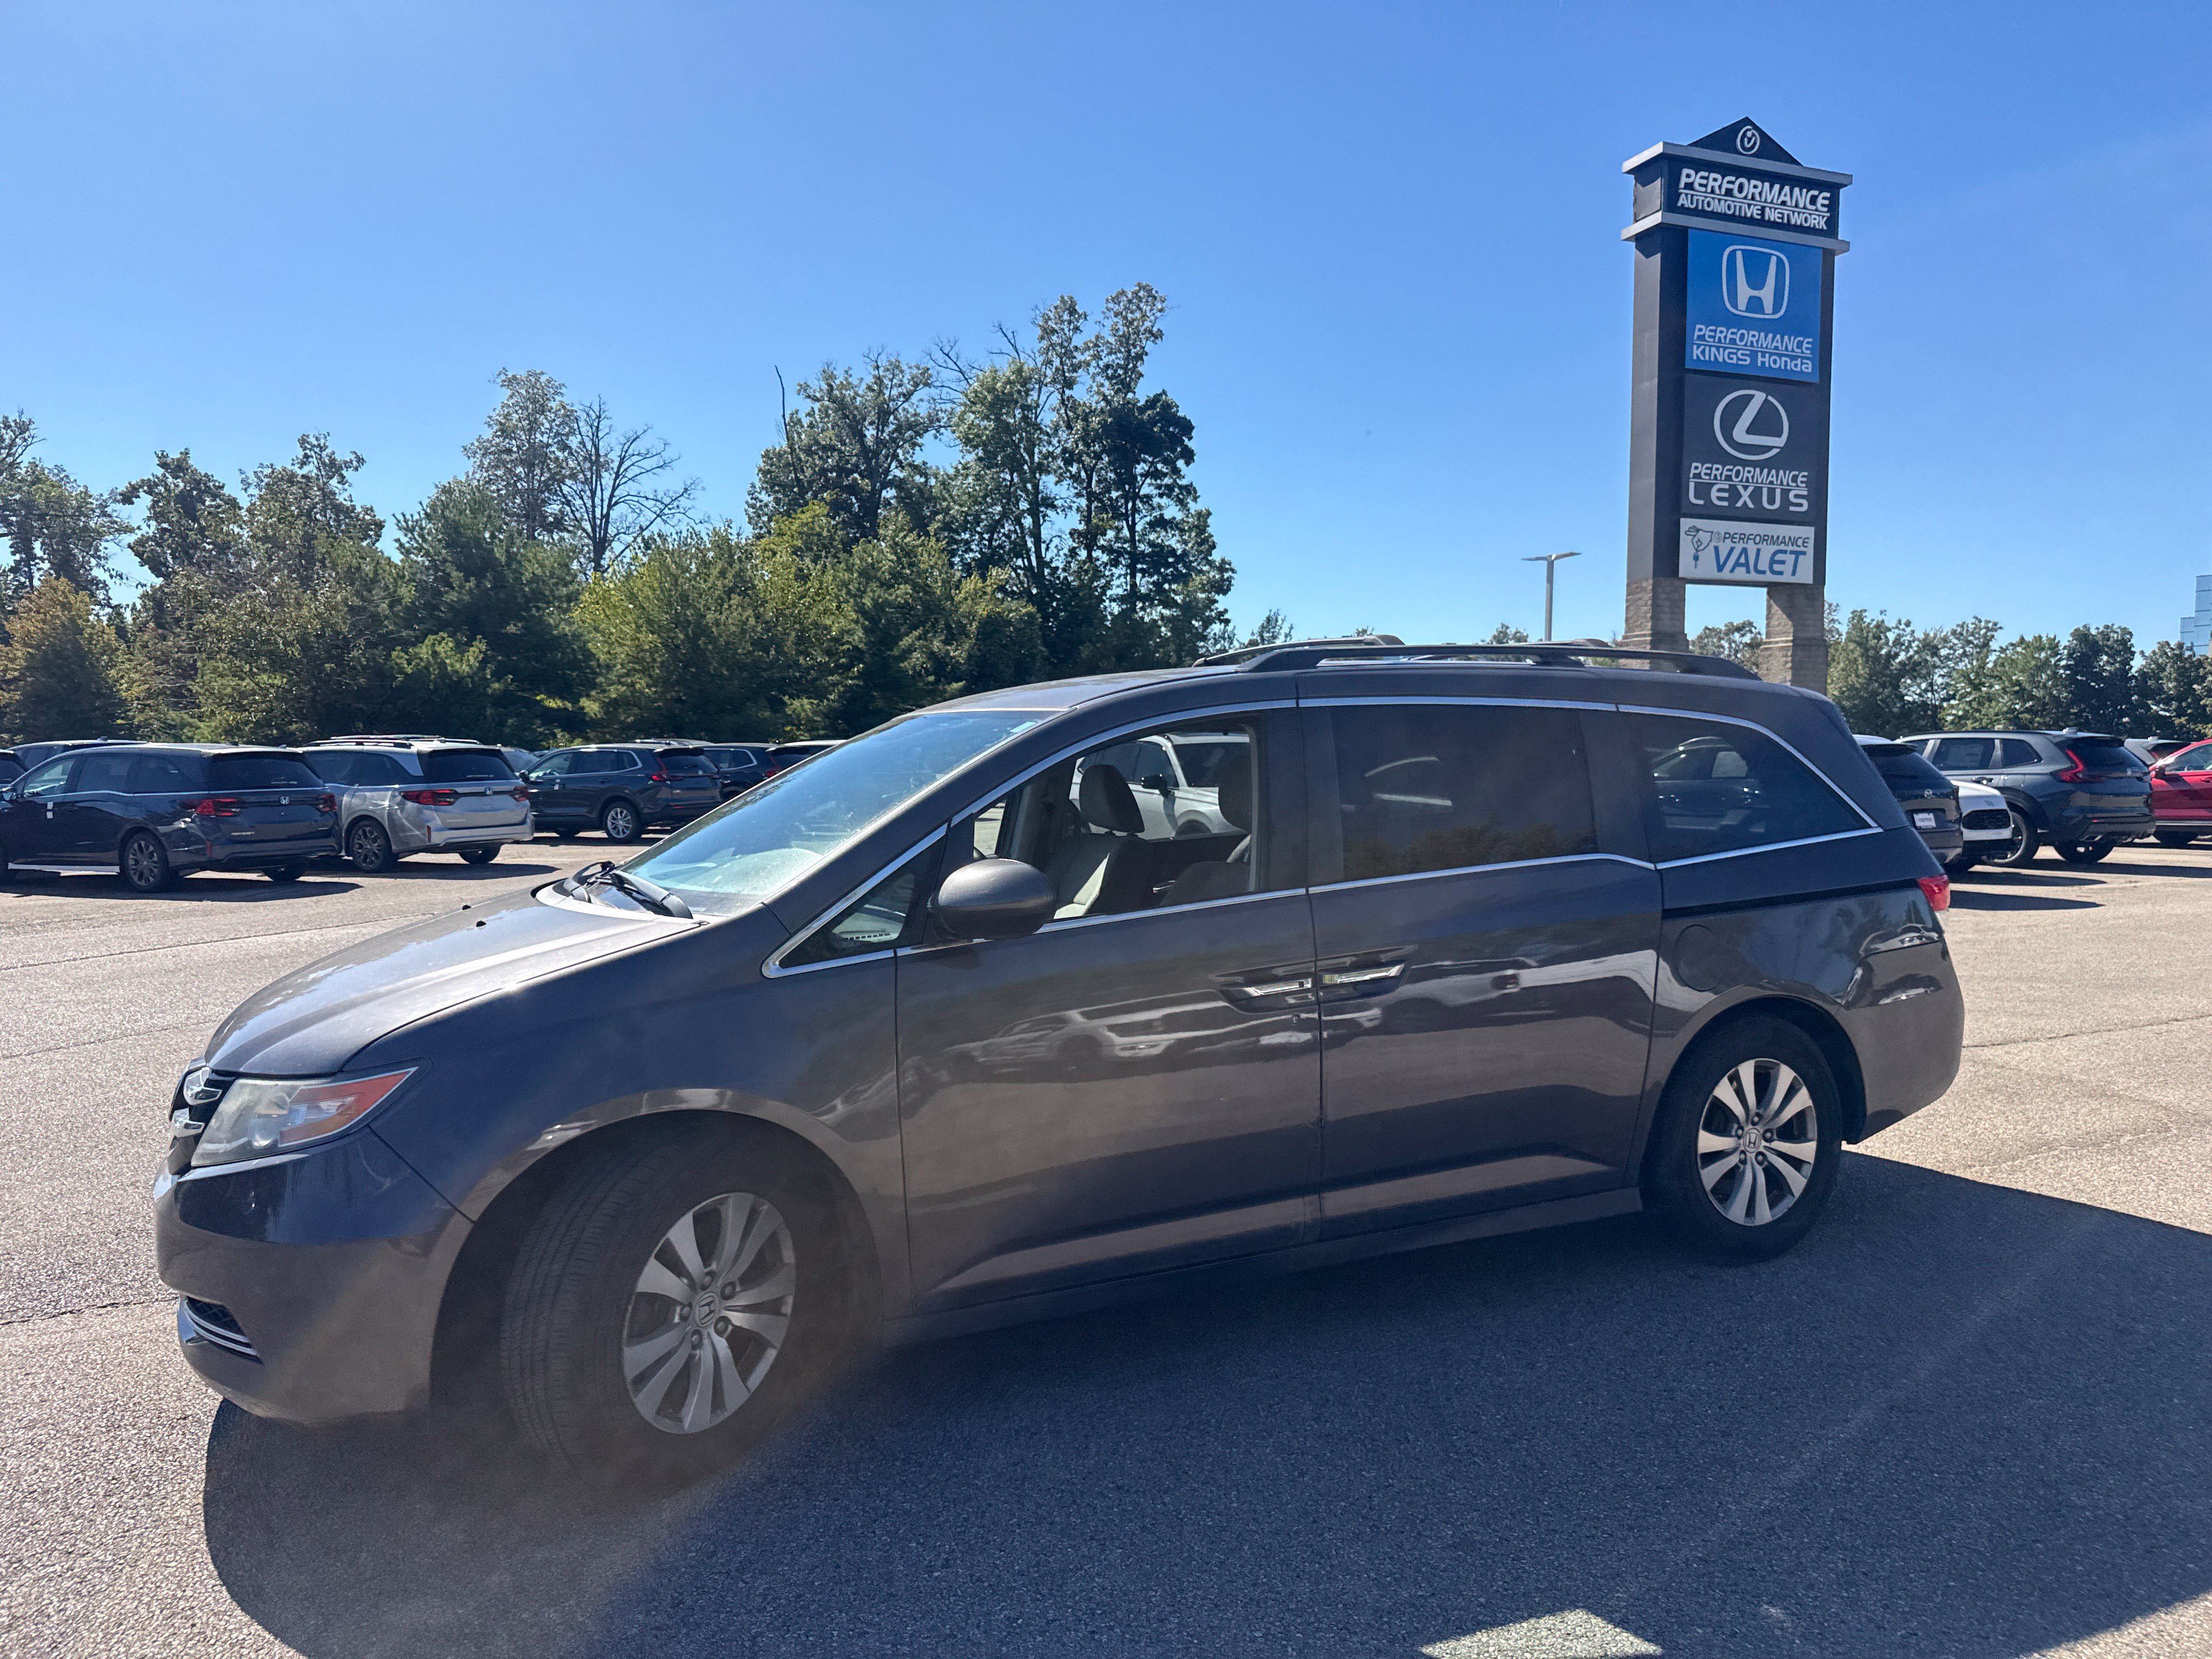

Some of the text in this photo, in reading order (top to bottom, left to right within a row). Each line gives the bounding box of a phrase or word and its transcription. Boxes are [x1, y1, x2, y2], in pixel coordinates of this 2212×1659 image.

[1678, 168, 1831, 212] PERFORMANCE
[1677, 193, 1827, 230] AUTOMOTIVE NETWORK
[1694, 324, 1813, 354] PERFORMANCE
[1692, 345, 1812, 373] KINGS Honda
[1689, 462, 1808, 487] PERFORMANCE
[1689, 481, 1808, 512] LEXUS
[1722, 532, 1809, 548] PERFORMANCE
[1713, 545, 1807, 577] VALET
